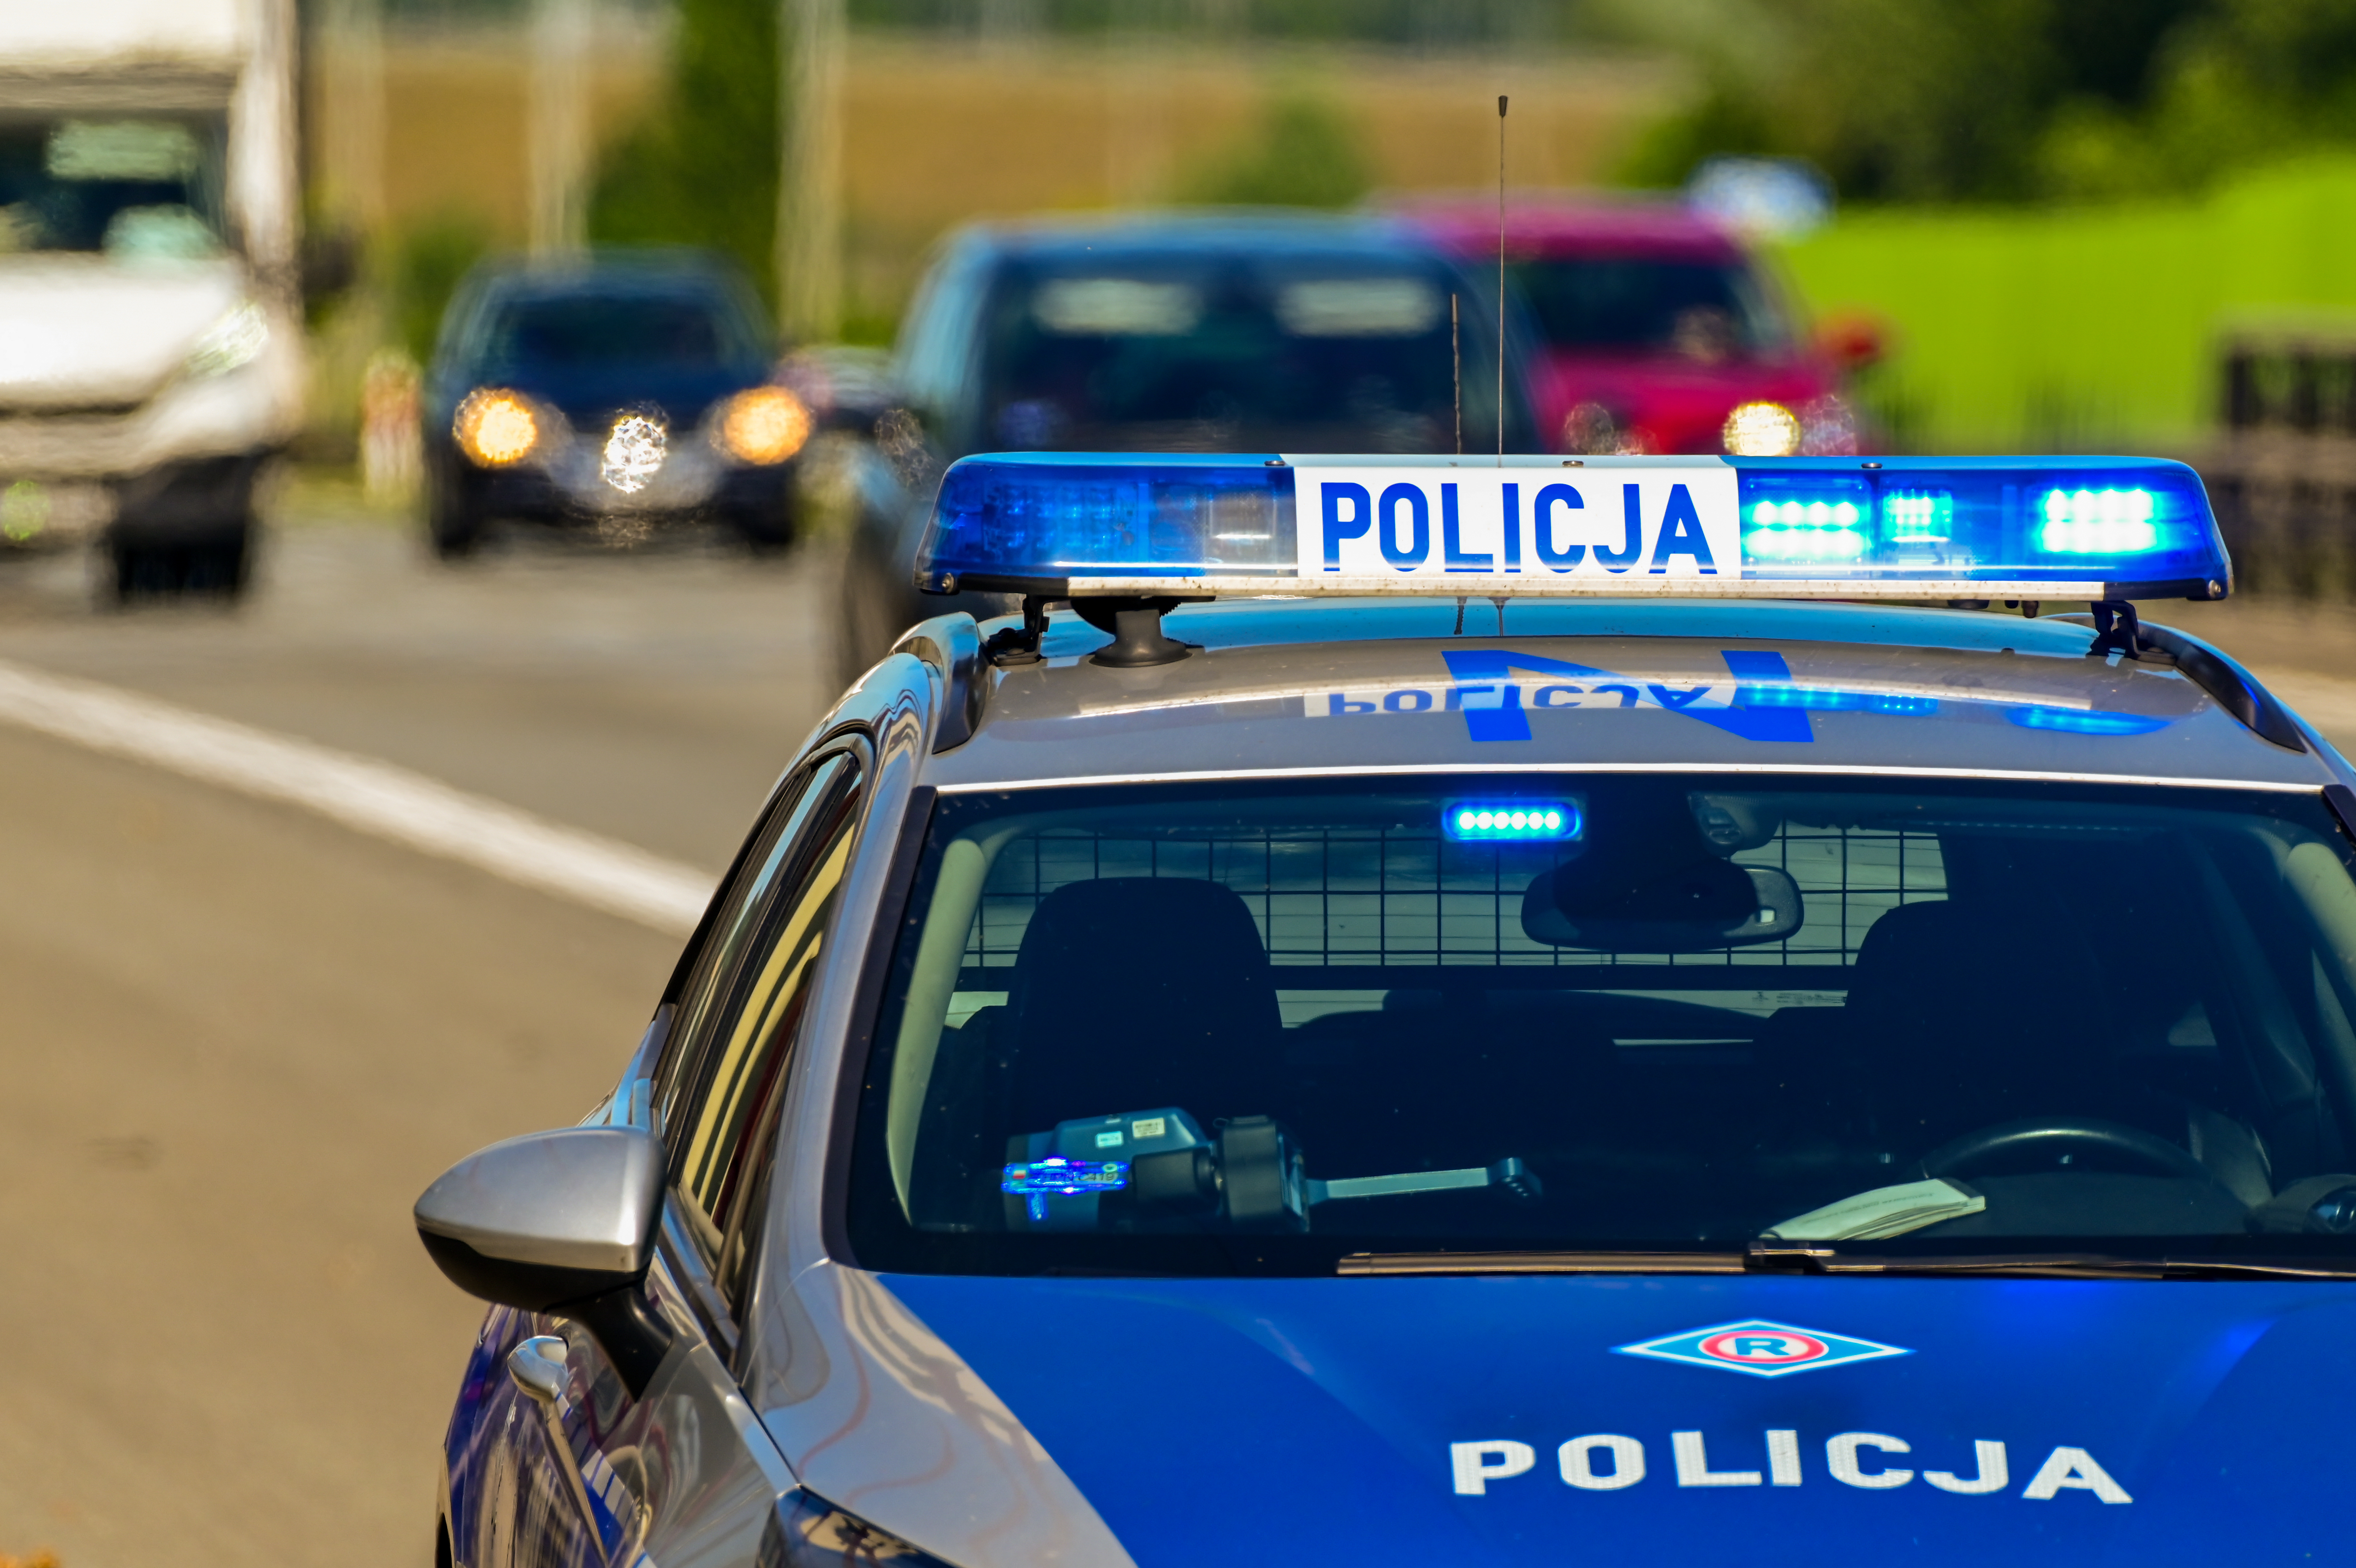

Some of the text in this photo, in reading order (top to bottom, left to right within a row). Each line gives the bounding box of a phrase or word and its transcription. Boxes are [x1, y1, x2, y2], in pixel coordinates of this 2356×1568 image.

[1321, 482, 1718, 575] POLICJA
[1441, 650, 1814, 742] N
[1735, 1337, 1791, 1356] R
[1451, 1430, 2133, 1504] POLICJA
